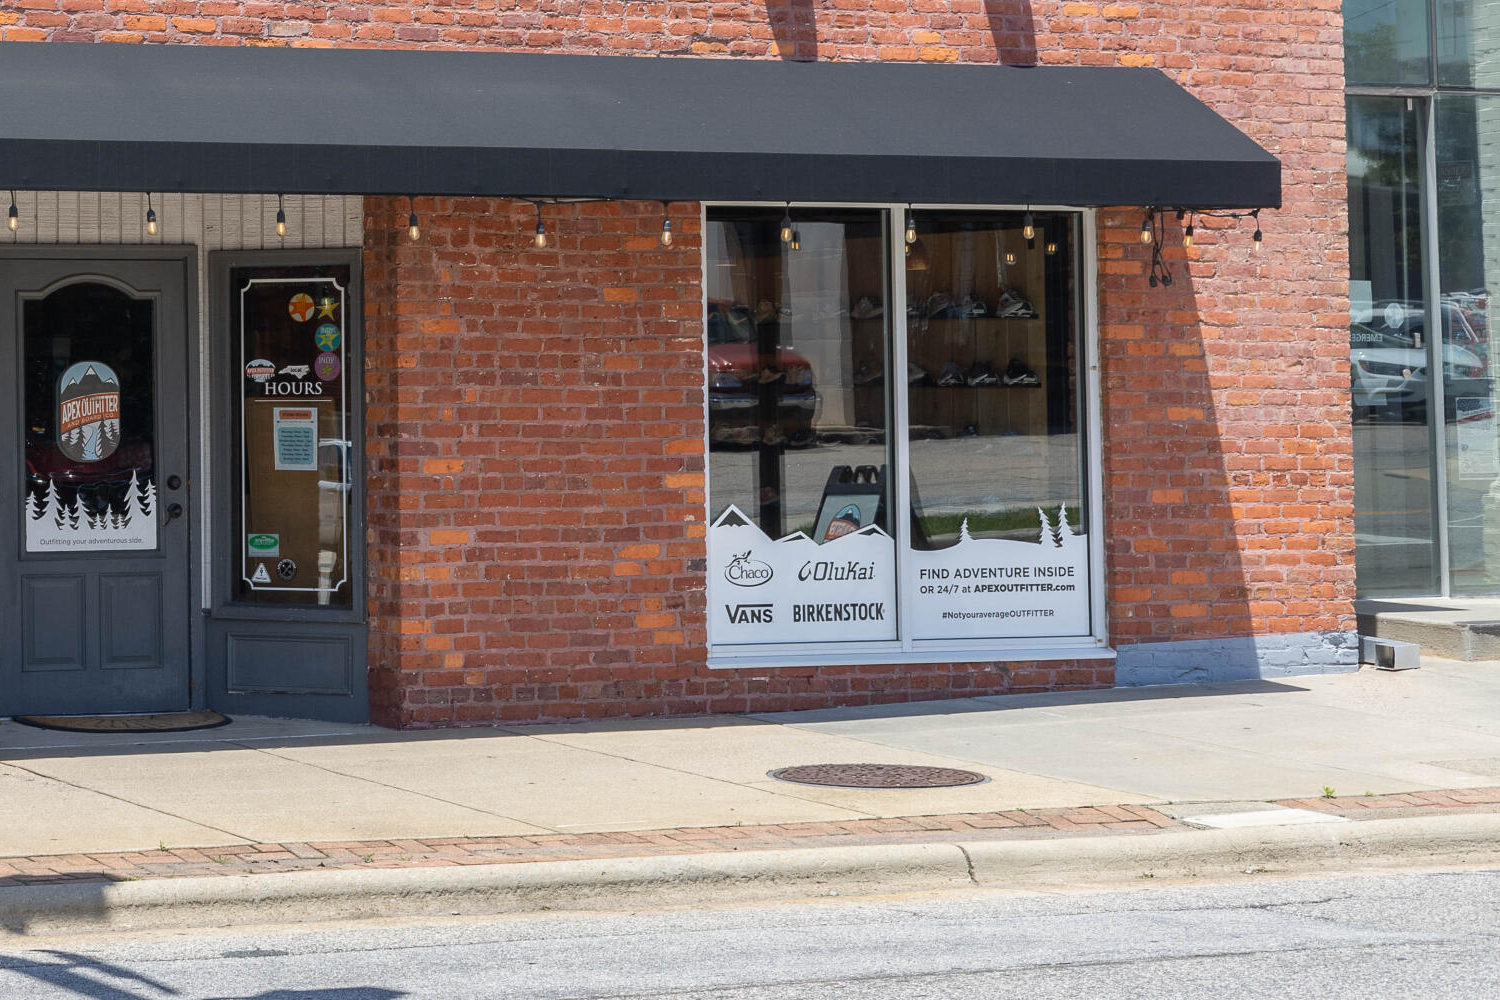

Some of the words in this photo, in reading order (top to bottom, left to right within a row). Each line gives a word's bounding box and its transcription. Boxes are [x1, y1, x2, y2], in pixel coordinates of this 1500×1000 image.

[265, 381, 323, 395] HOURS
[62, 399, 81, 424] APEX
[81, 394, 118, 417] OUTFITTER
[40, 537, 71, 546] Outfitting
[73, 538, 87, 546] your
[88, 537, 128, 545] adventurous
[728, 564, 770, 581] Chaco
[813, 561, 875, 581] OluKai
[920, 569, 949, 579] FIND
[954, 567, 1030, 579] ADVENTURE
[1034, 566, 1074, 577] INSIDE
[920, 585, 934, 594] OR
[937, 584, 959, 595] 24/7
[962, 584, 971, 593] at
[974, 583, 1075, 593] APEXOUTFITTER.com
[725, 603, 773, 624] VANS
[793, 602, 884, 622] BIRKENSTOCK
[942, 610, 1054, 619] #NotyouraverageOUTFITTER
